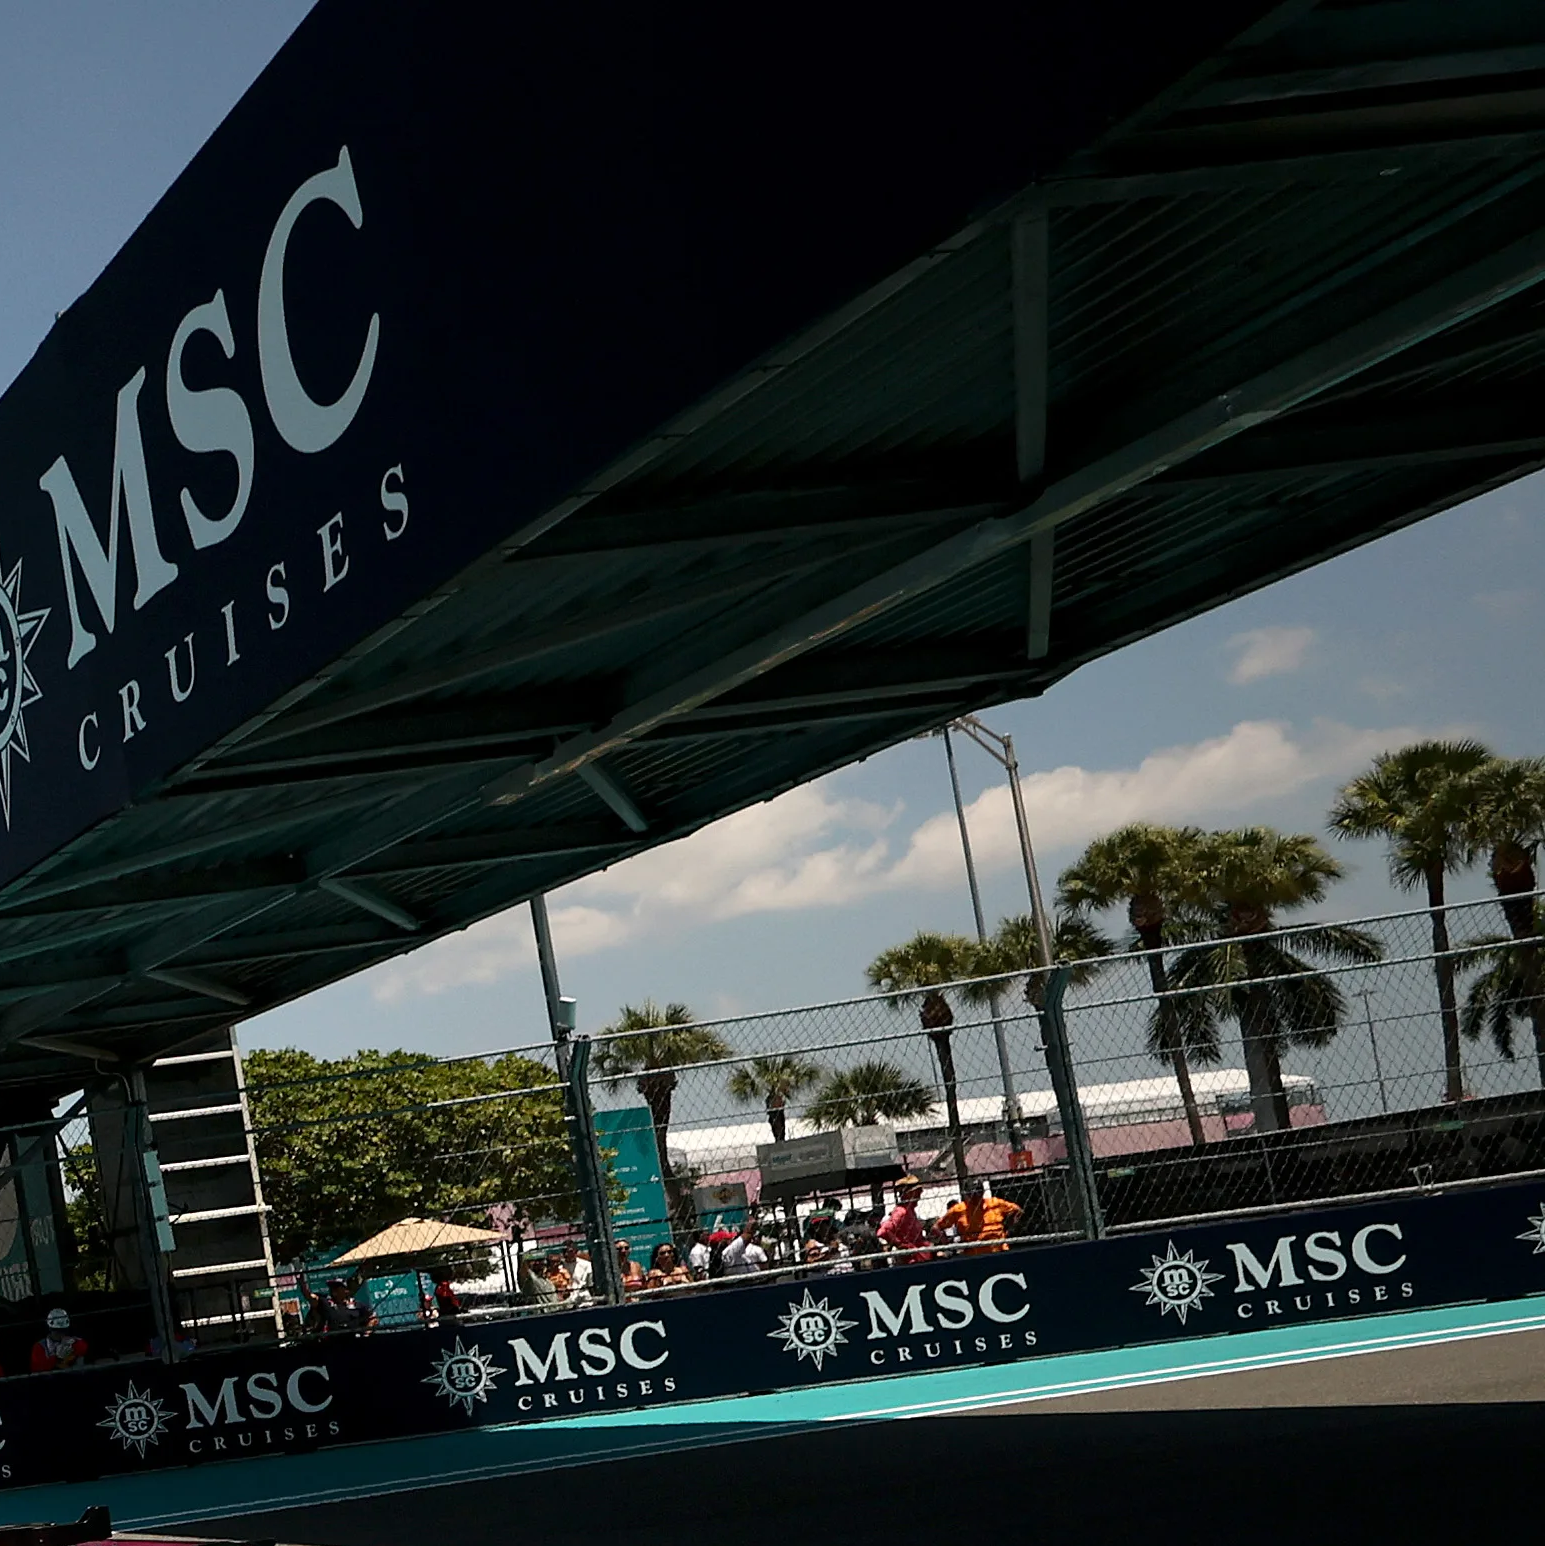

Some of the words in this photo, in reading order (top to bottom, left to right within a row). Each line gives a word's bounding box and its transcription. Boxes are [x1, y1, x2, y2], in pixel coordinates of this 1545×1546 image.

[40, 144, 379, 670] MSC
[77, 463, 410, 772] CRUISES
[1226, 1224, 1406, 1293] MSC
[860, 1273, 1030, 1339] MSC
[1238, 1282, 1414, 1320] CRUISES
[508, 1320, 668, 1386] MSC
[871, 1330, 1037, 1365] CRUISES
[179, 1366, 333, 1429] MSC
[518, 1377, 676, 1411] CRUISES
[189, 1420, 340, 1453] CRUISES
